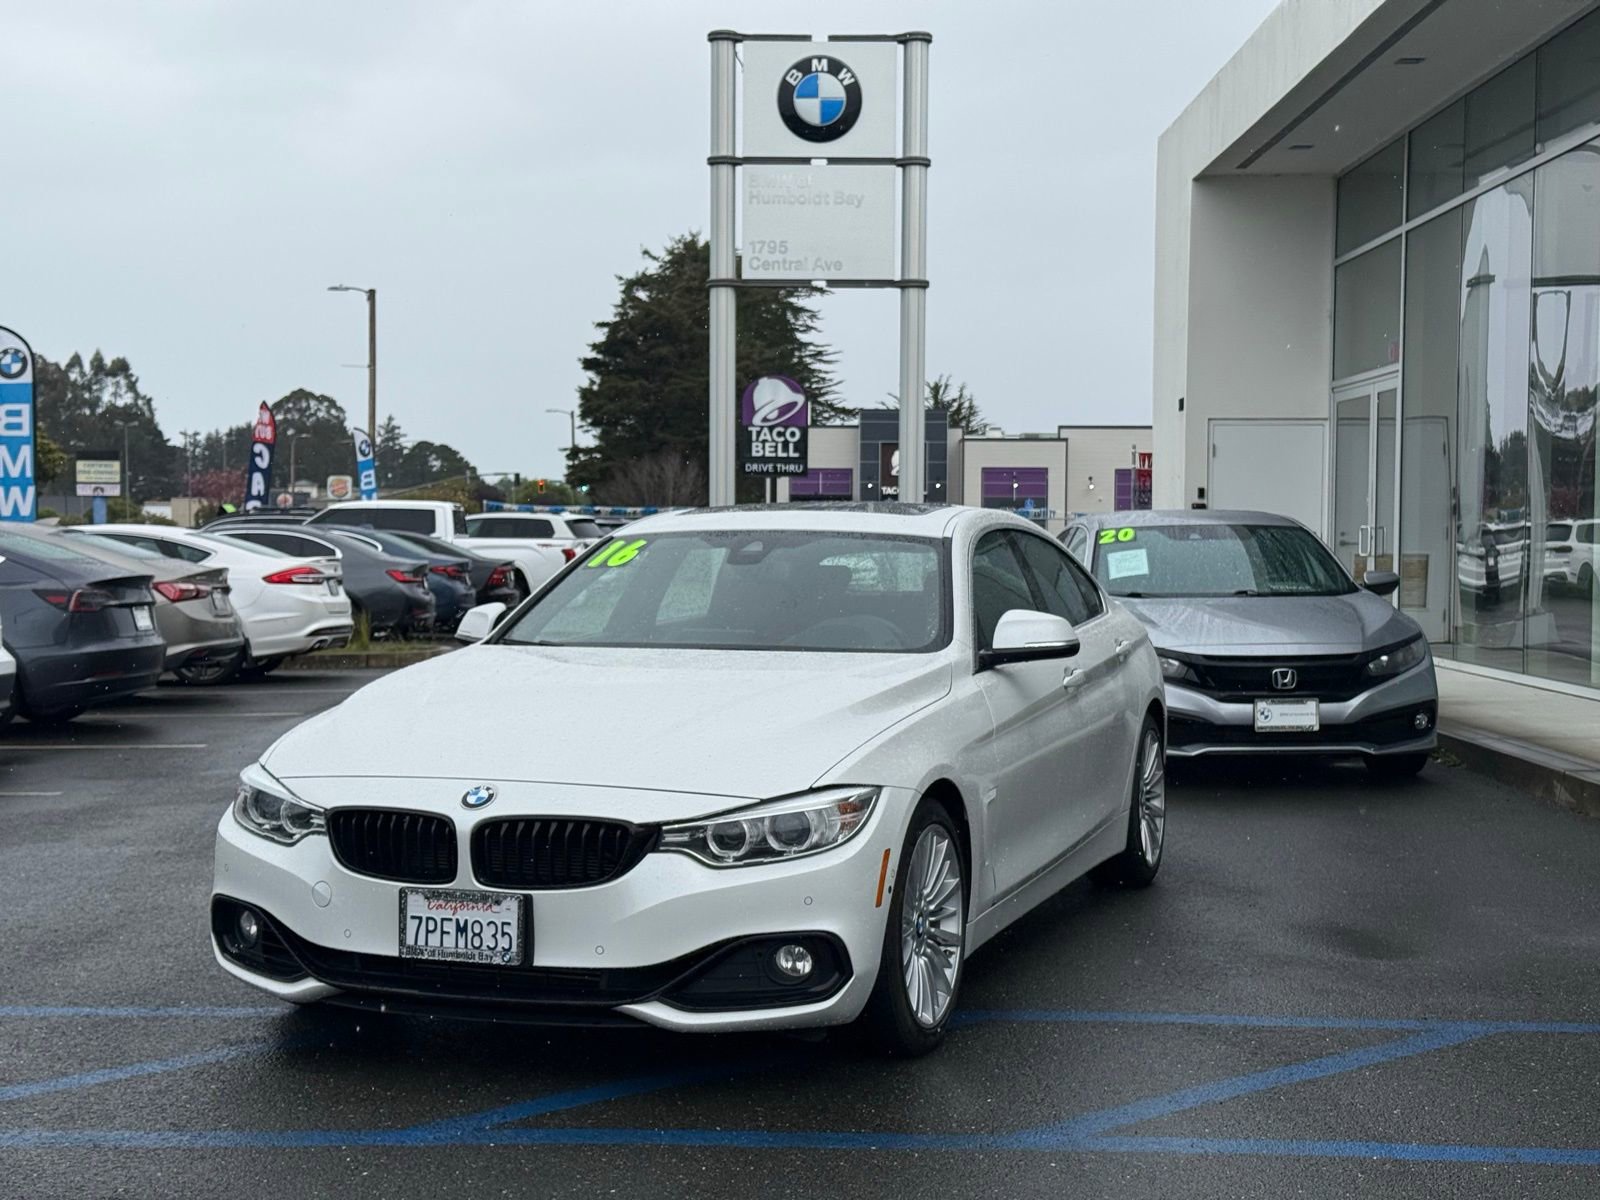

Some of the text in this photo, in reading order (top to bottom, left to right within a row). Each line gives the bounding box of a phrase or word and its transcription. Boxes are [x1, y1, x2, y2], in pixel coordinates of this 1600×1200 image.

[785, 58, 856, 87] BMW
[748, 191, 865, 209] Humboldt Bay
[748, 240, 789, 255] 1795
[812, 256, 844, 272] Ave
[748, 426, 801, 443] TACO
[751, 441, 800, 458] BELL
[744, 462, 804, 474] DRIVE THRU
[881, 486, 899, 496] TAC
[1098, 527, 1136, 545] 20
[586, 538, 648, 568] 16
[410, 915, 513, 952] 7PFM835
